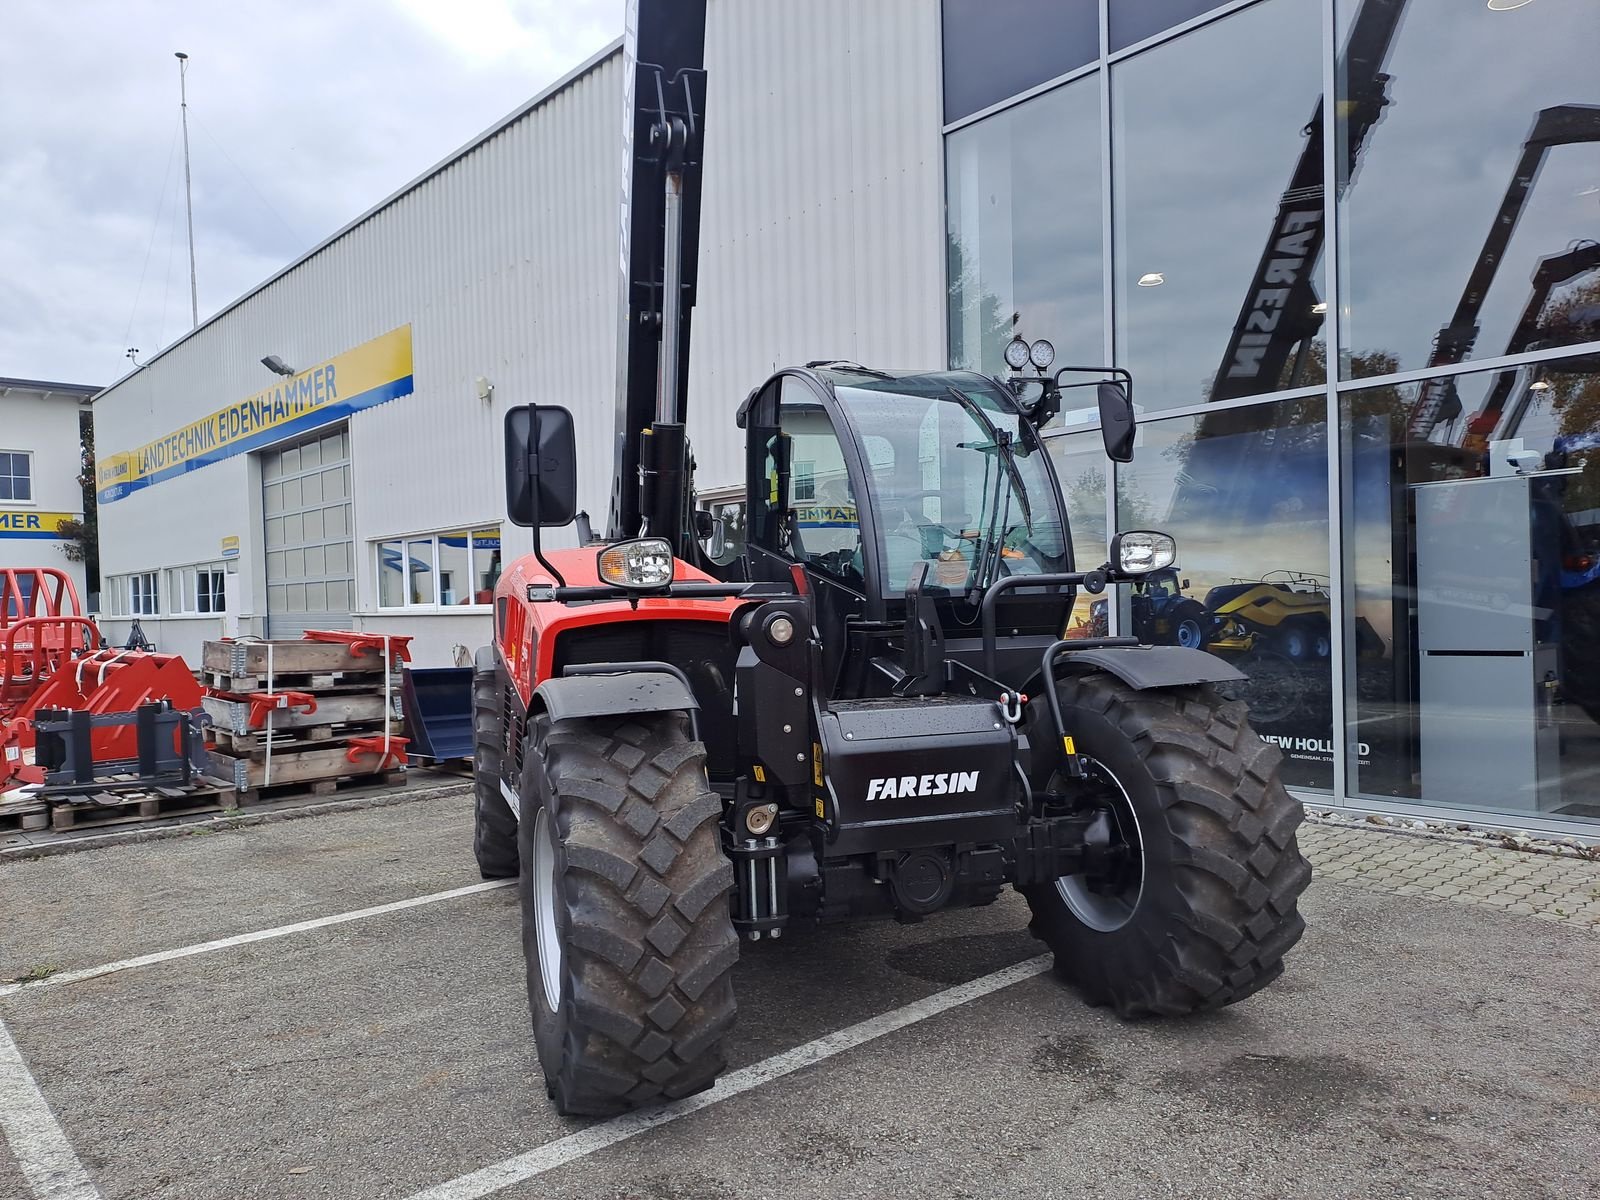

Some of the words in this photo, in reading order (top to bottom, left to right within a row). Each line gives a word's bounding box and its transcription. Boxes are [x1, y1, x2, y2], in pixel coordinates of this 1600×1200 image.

[138, 417, 216, 475] LANDTECHNIK
[218, 364, 337, 443] EIDENHAMMER
[1295, 738, 1370, 756] HOLLD
[865, 770, 980, 801] FARESIN
